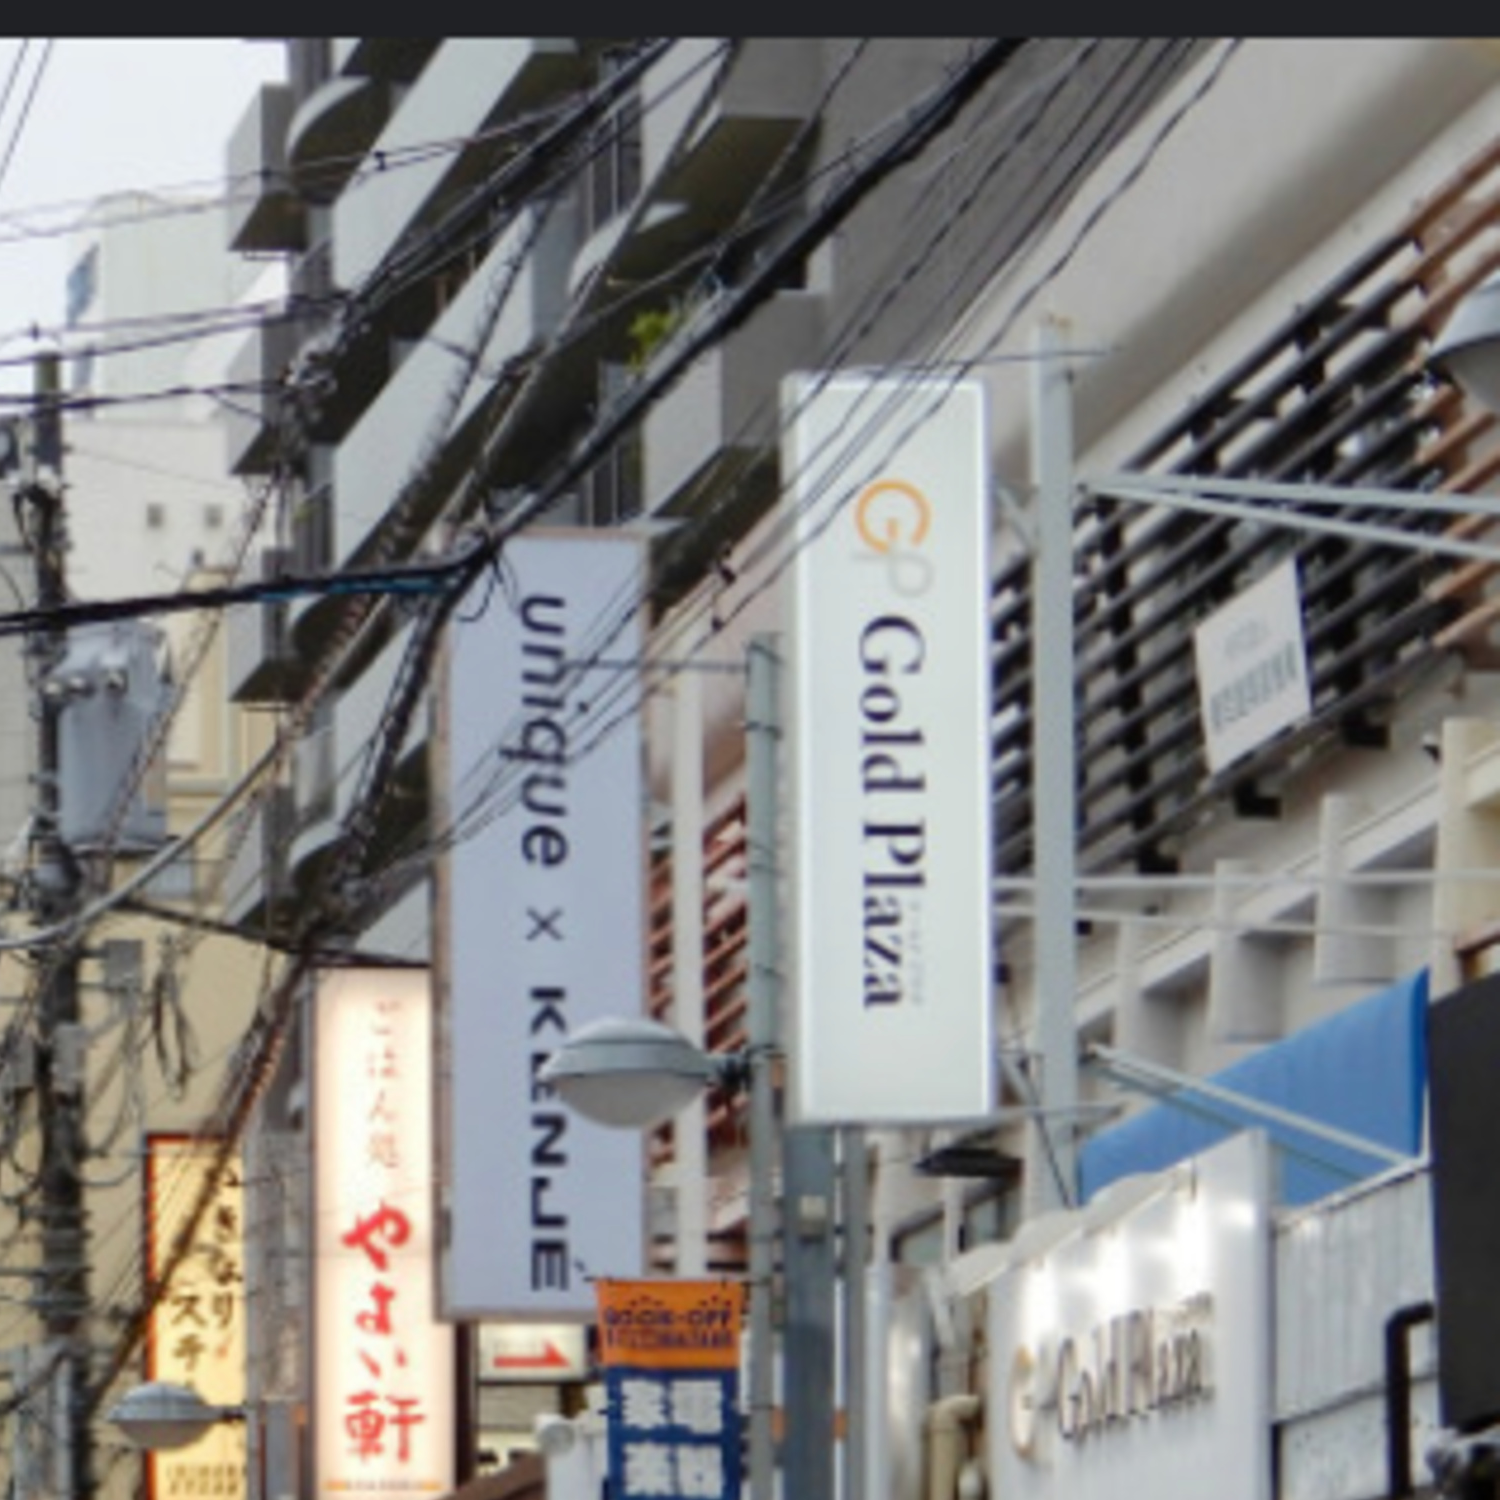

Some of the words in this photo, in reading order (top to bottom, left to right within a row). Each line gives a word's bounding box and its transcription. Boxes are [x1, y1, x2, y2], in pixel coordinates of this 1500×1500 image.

[499, 593, 569, 869] unique
[859, 614, 926, 795] Gold
[862, 817, 926, 1009] Plaza
[341, 1202, 426, 1464] やよい軒
